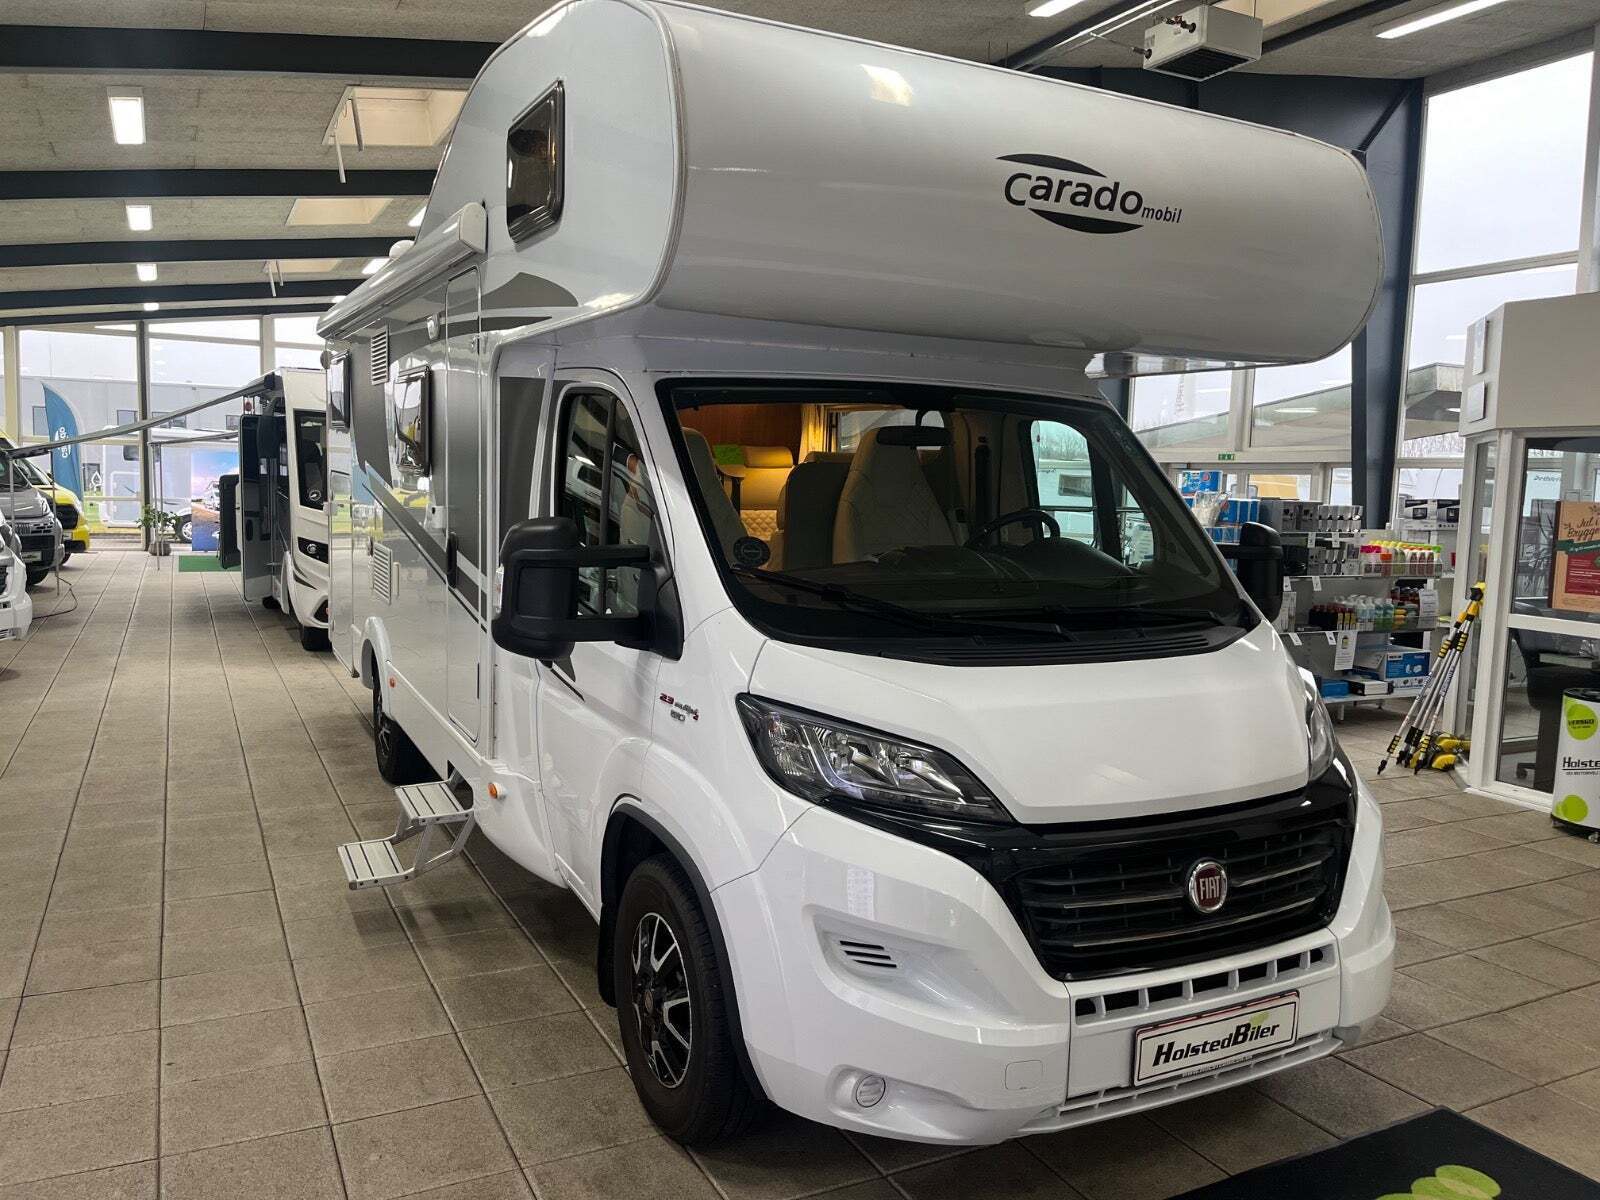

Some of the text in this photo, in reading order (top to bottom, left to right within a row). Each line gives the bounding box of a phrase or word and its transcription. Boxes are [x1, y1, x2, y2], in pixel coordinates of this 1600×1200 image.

[1004, 172, 1182, 223] Carado mobil
[1200, 875, 1221, 900] FIAT
